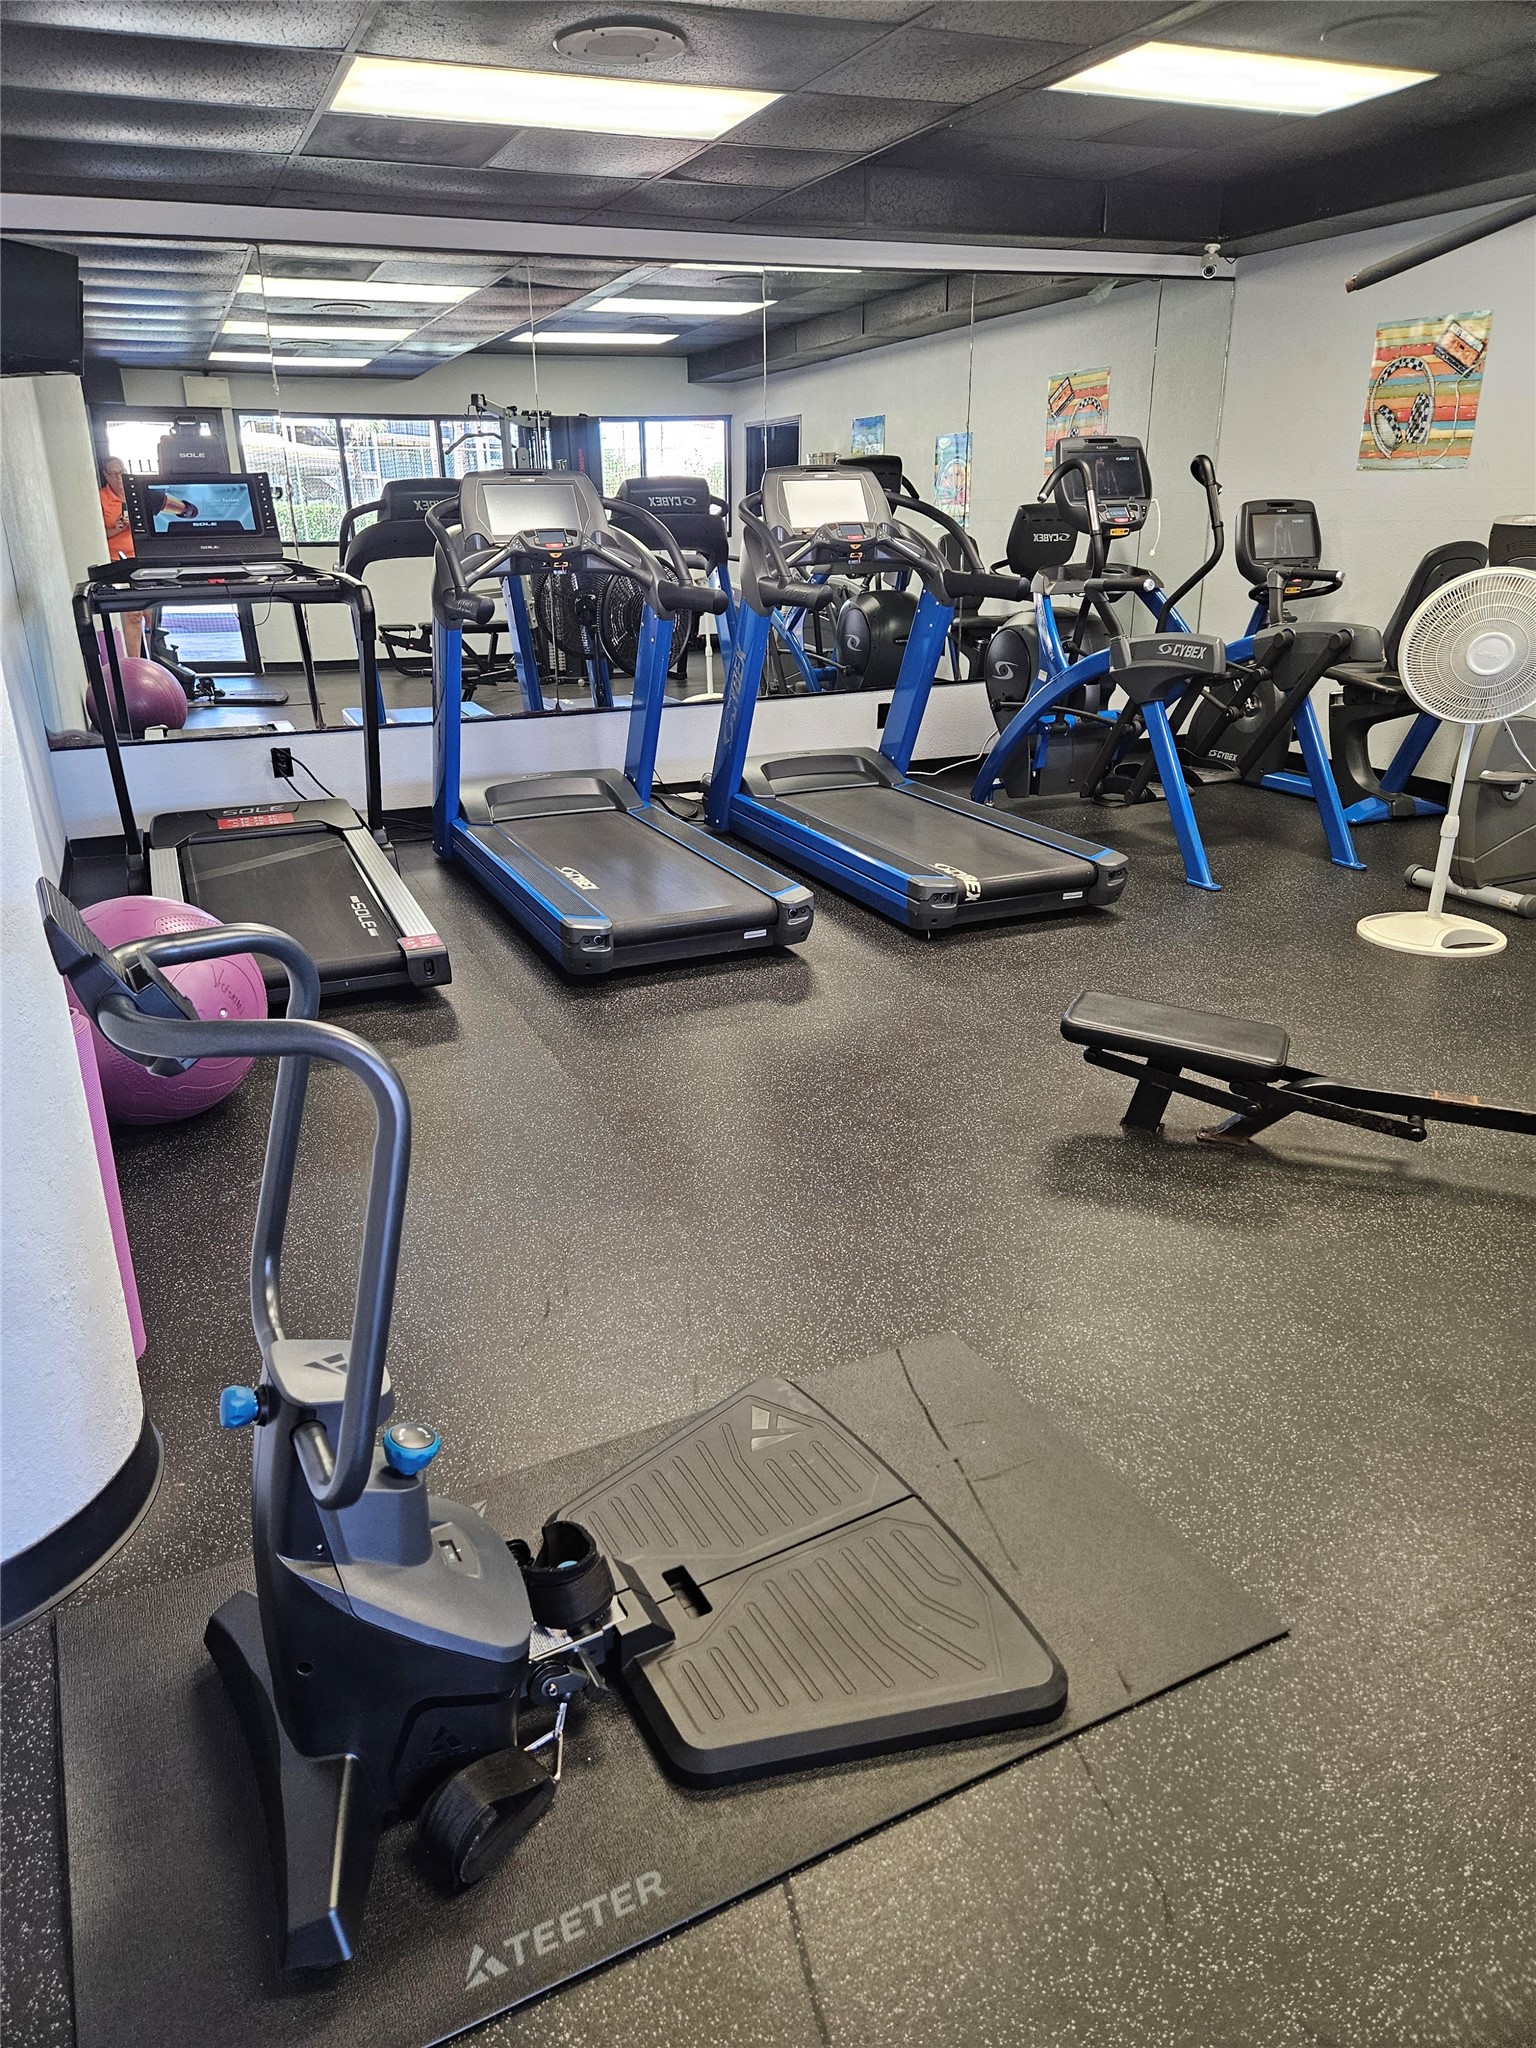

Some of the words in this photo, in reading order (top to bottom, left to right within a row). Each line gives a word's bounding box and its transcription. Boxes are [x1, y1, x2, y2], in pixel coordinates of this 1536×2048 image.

[1171, 643, 1208, 660] CYBEX
[1216, 750, 1238, 762] CYBEX
[222, 804, 285, 817] SOLE
[350, 901, 378, 930] SOLE
[502, 1870, 667, 1967] TEETER
